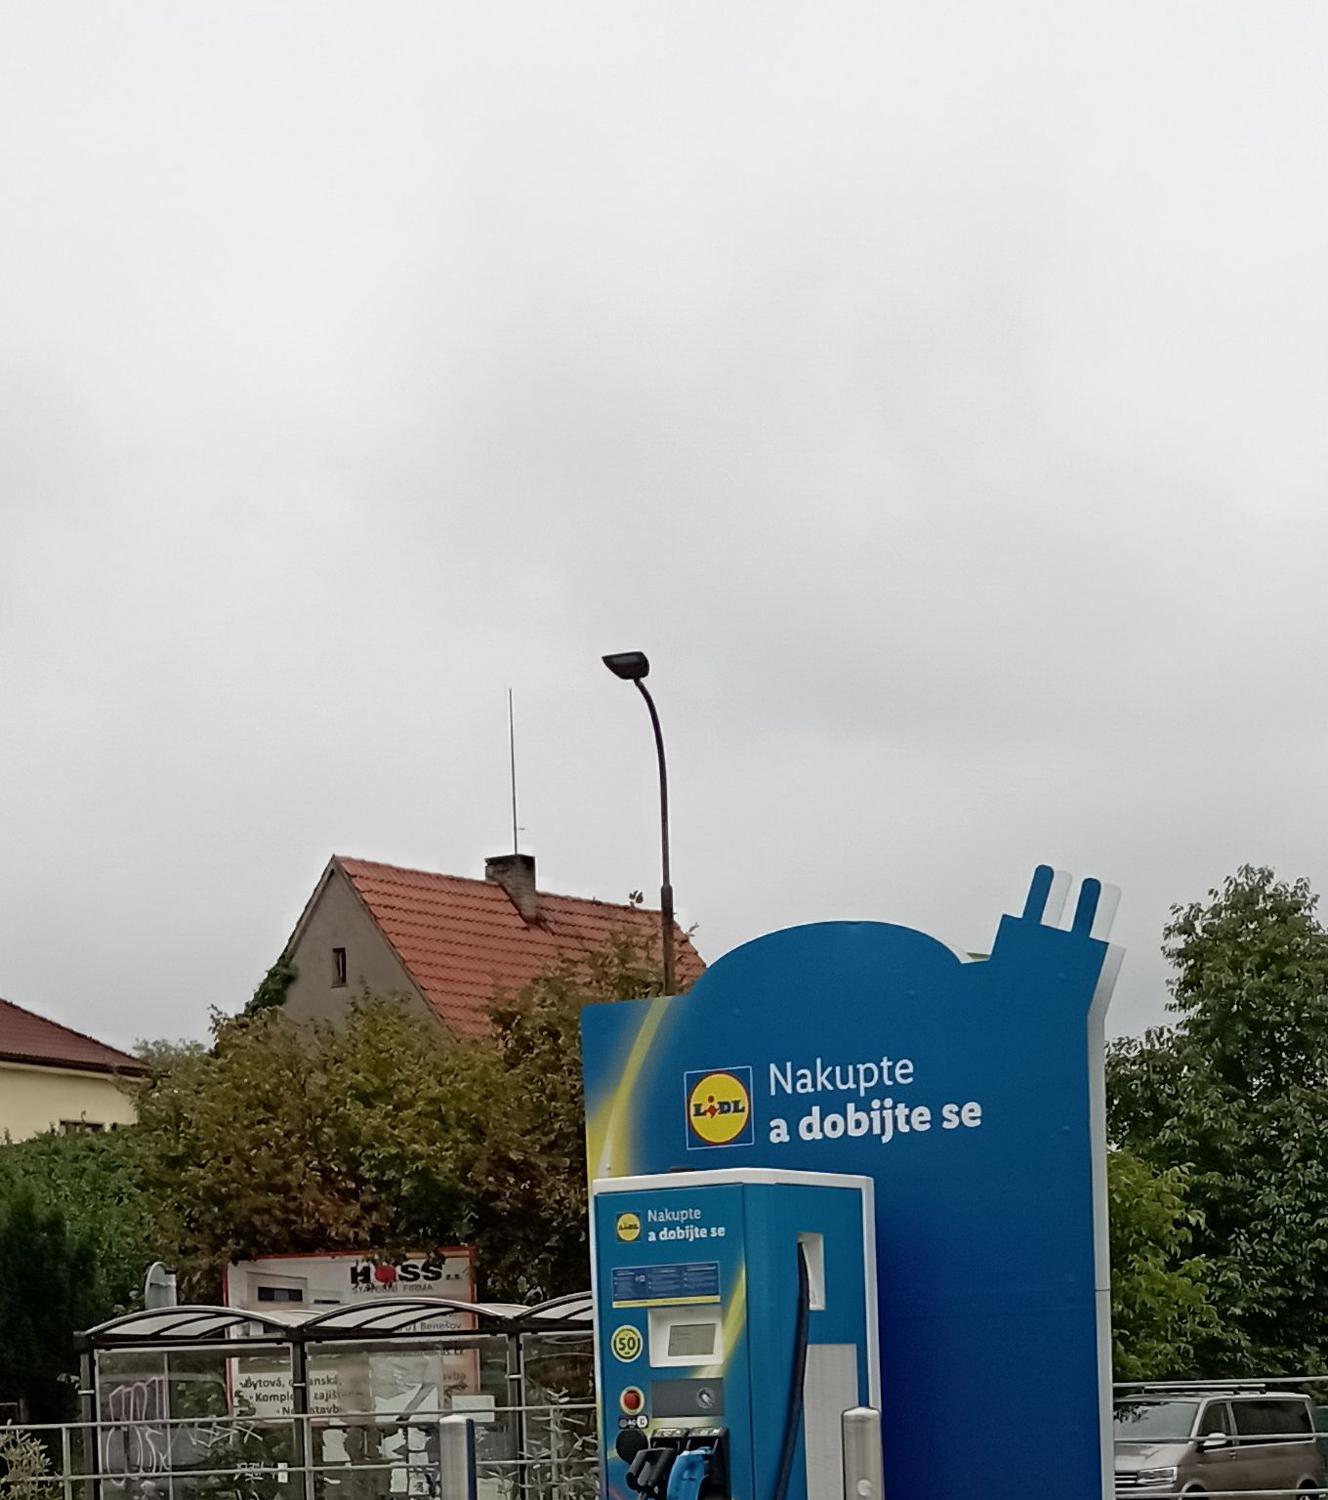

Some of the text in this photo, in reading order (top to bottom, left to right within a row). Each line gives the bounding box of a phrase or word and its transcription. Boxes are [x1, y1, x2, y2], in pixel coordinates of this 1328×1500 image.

[768, 1055, 915, 1098] Nakupte
[768, 1098, 983, 1144] a dobijte se
[647, 1208, 702, 1223] Nakupte
[648, 1225, 727, 1243] a dobijte se
[421, 1320, 463, 1330] Benešov
[618, 1336, 637, 1352] 50
